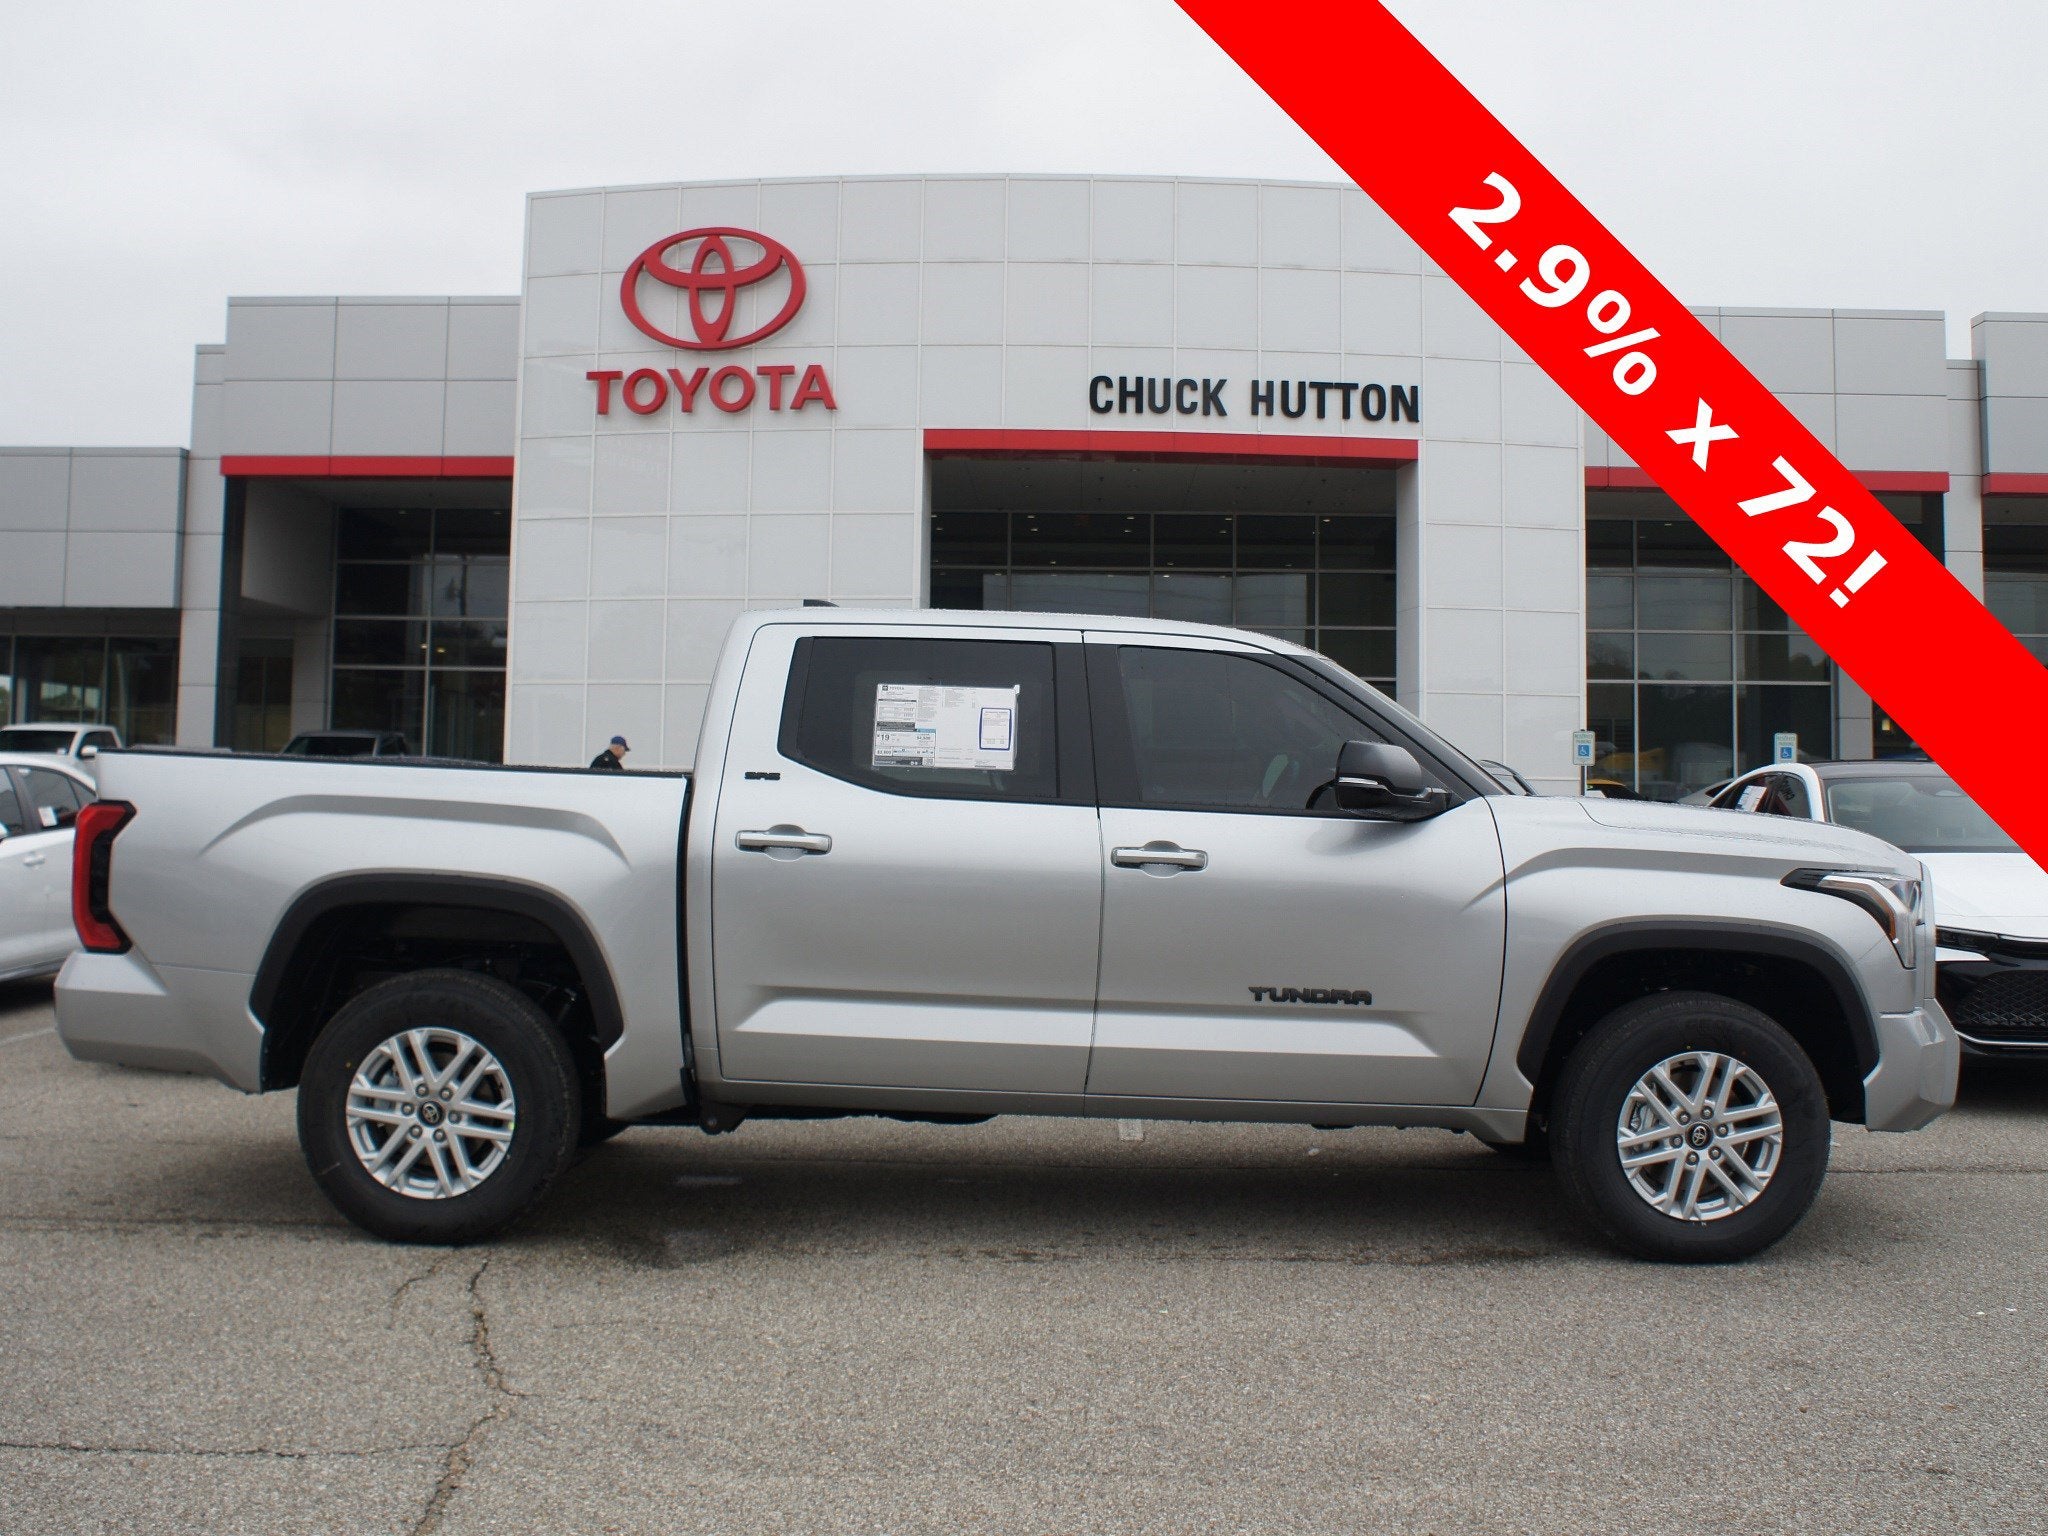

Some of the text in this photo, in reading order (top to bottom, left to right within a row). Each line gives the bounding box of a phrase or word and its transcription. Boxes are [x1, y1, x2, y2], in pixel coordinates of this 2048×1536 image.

[586, 364, 837, 415] TOYOTA
[1089, 375, 1421, 423] CHUCK HUTTON
[1248, 986, 1373, 1006] TUNDRA
